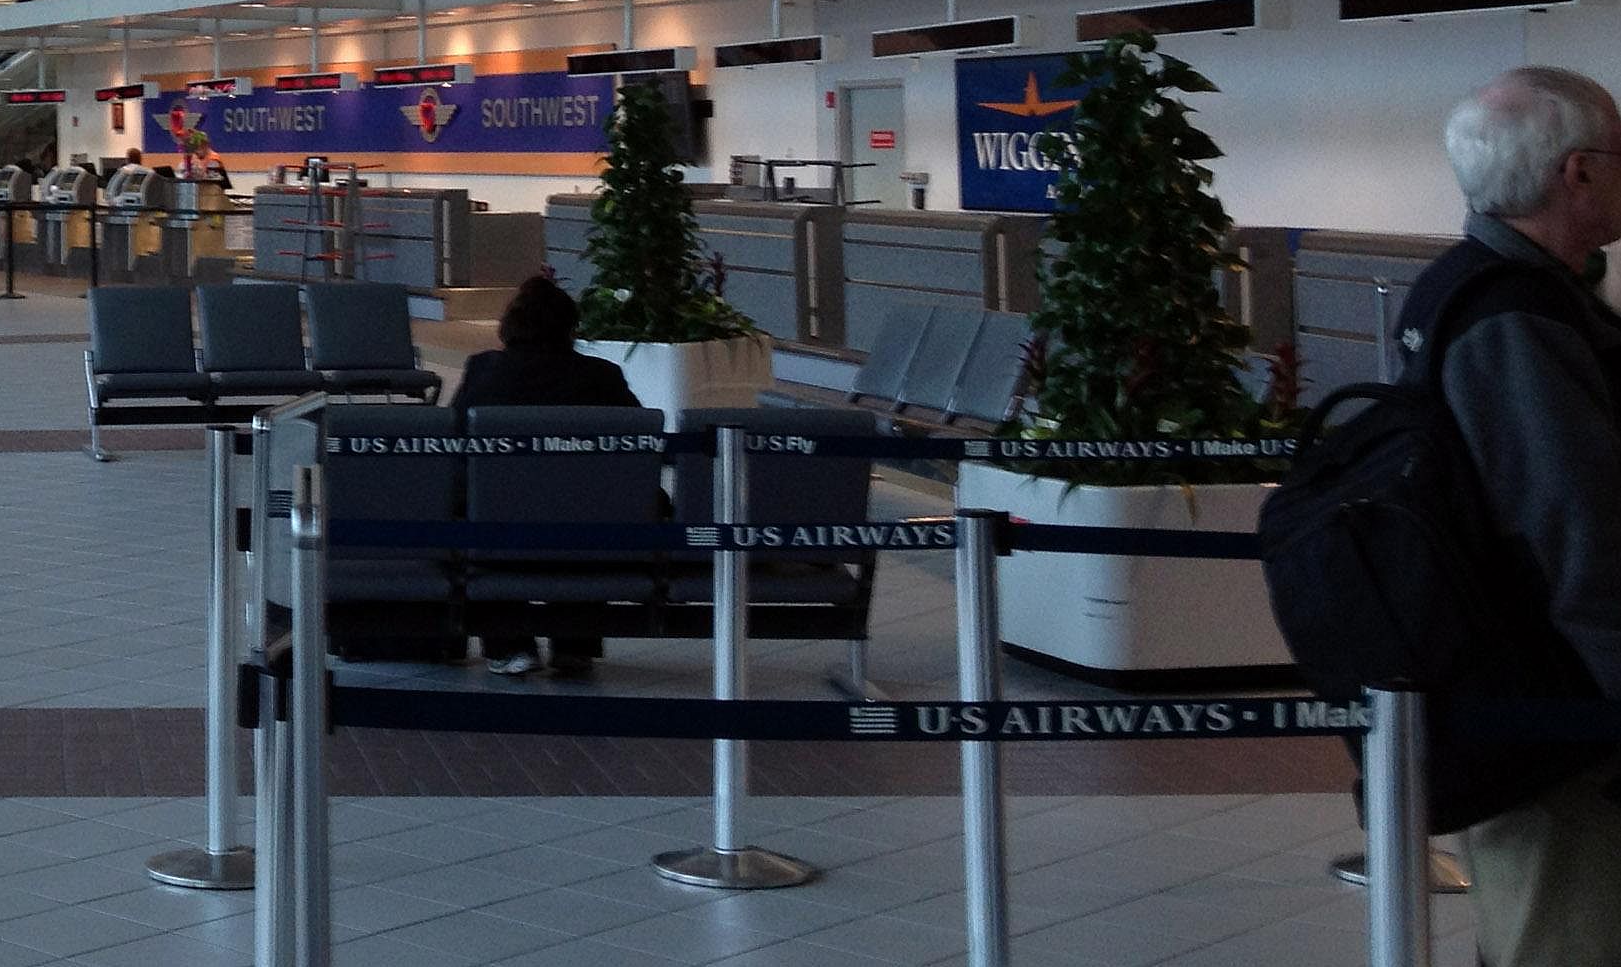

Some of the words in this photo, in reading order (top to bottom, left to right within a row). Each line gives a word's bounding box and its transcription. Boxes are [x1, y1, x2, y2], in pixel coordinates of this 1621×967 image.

[224, 97, 326, 132] SOUTHWEST
[482, 95, 600, 128] SOUTHWEST
[393, 436, 513, 453] AIRWAYS
[543, 435, 595, 452] Make
[1045, 440, 1174, 457] AIRWAYS
[1202, 440, 1256, 456] Make
[790, 525, 953, 546] AIRWAYS
[1001, 703, 1234, 734] AIRWAYS
